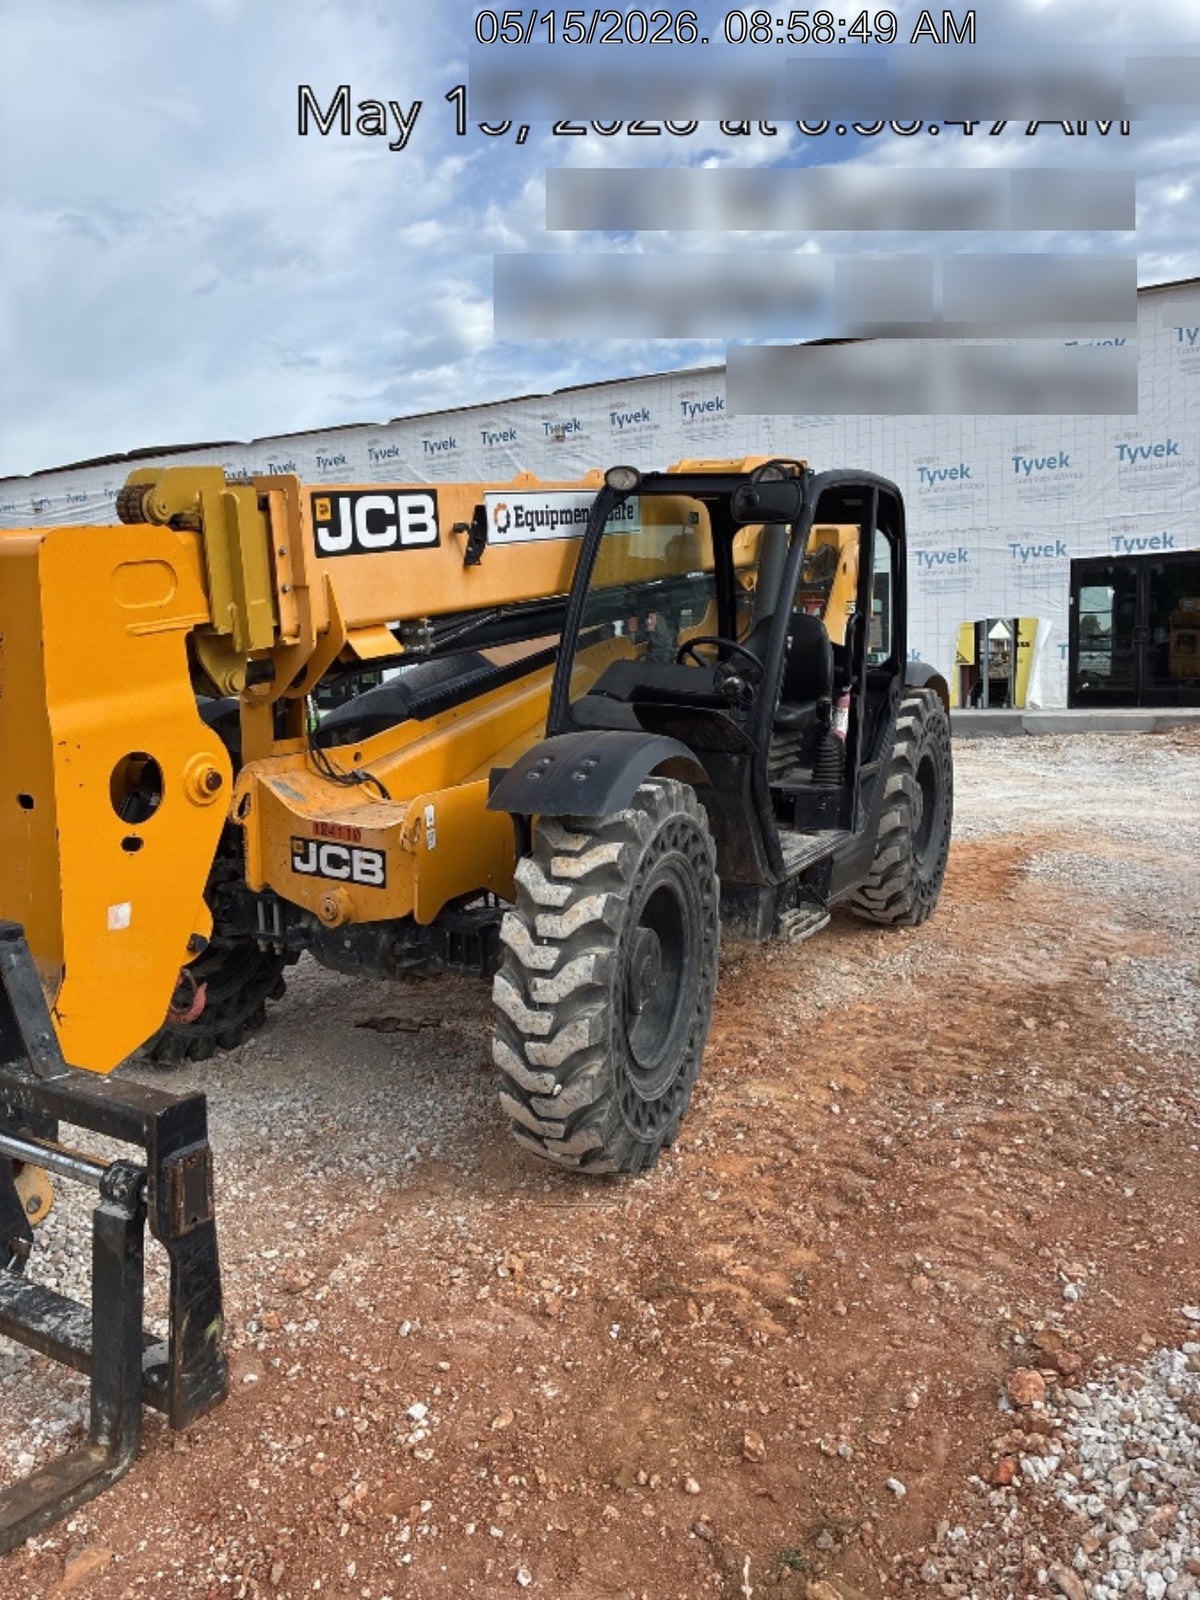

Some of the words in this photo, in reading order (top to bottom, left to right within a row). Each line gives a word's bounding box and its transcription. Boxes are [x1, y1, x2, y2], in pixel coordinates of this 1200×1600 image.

[610, 406, 651, 430] Tyvek
[681, 396, 725, 418] Tyvek
[422, 436, 456, 455] Tyvek
[481, 423, 517, 446] Tyvek
[316, 454, 348, 470] Tyvek
[368, 445, 400, 462] Tyvek
[1116, 438, 1180, 465] Tyvek
[917, 463, 971, 487] Tyvek
[1011, 450, 1071, 477] Tyvek
[317, 493, 438, 552] JCB
[1009, 540, 1068, 565] Tyvek
[1112, 531, 1175, 554] Tyvek
[915, 547, 969, 569] Tyvek
[293, 841, 385, 885] JCB
